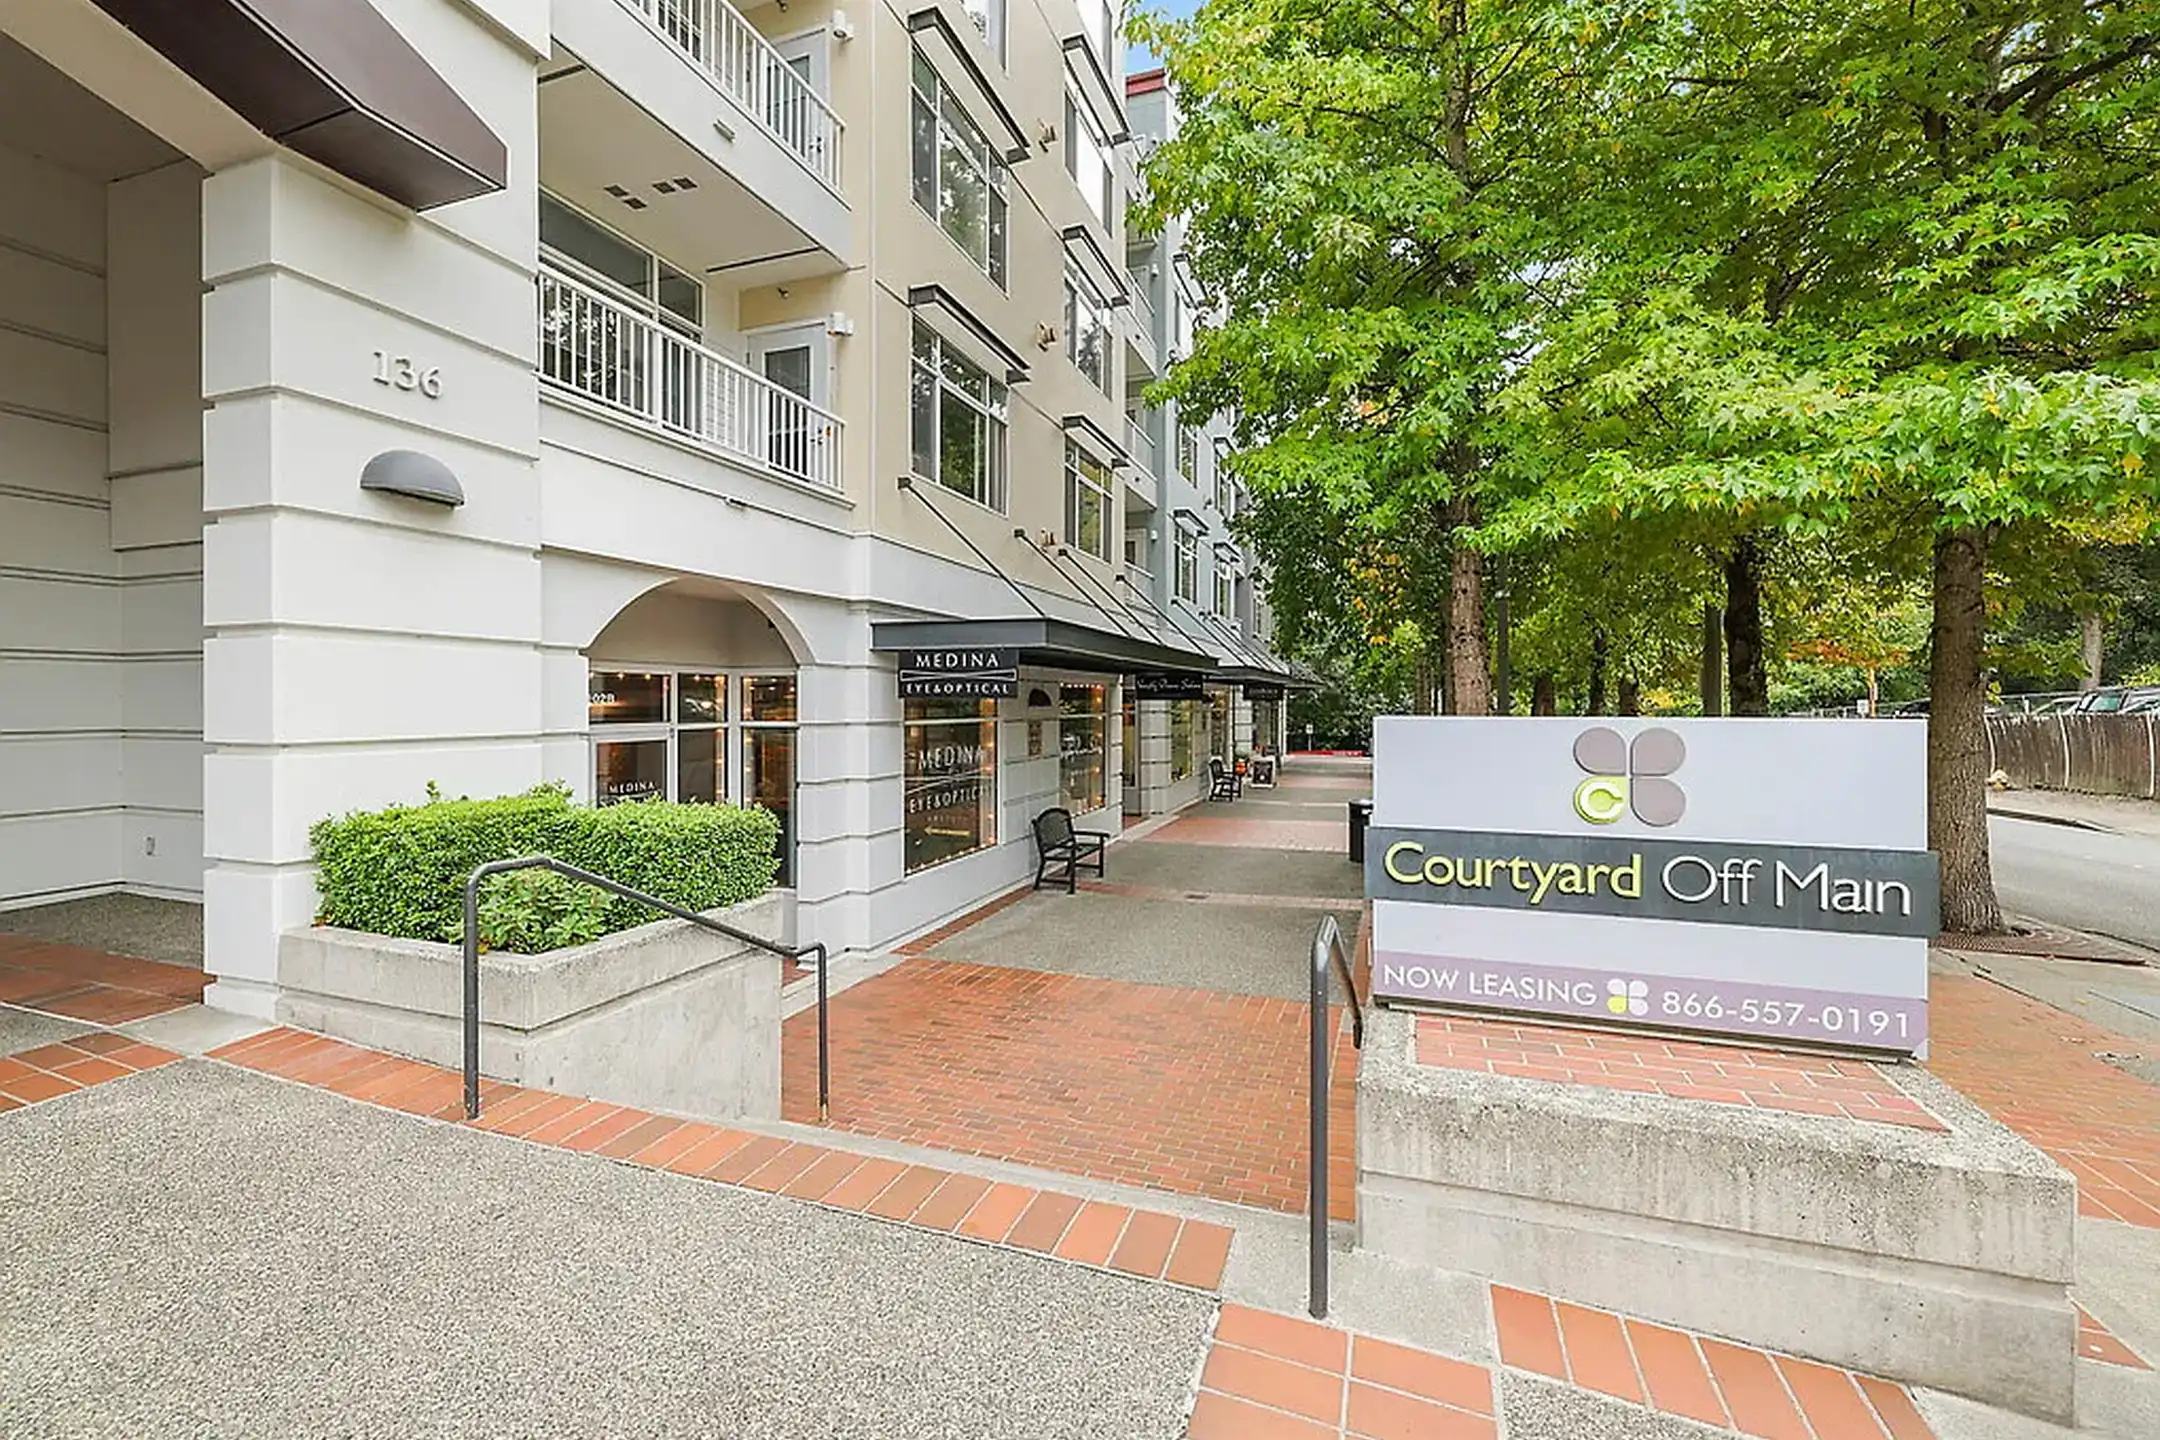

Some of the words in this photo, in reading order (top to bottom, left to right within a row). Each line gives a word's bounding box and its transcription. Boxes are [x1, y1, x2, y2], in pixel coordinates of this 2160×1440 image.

[372, 349, 442, 400] 136
[915, 652, 999, 668] MEDINA
[917, 744, 986, 770] MEDINA
[608, 780, 656, 794] MEDINA
[1384, 840, 1643, 905] Courtyard
[1660, 854, 1764, 905] Off
[1774, 859, 1912, 916] Main
[1383, 963, 1460, 991] NOW
[1469, 971, 1599, 1006] LEASING
[1661, 990, 1909, 1038] 866-557-0191
